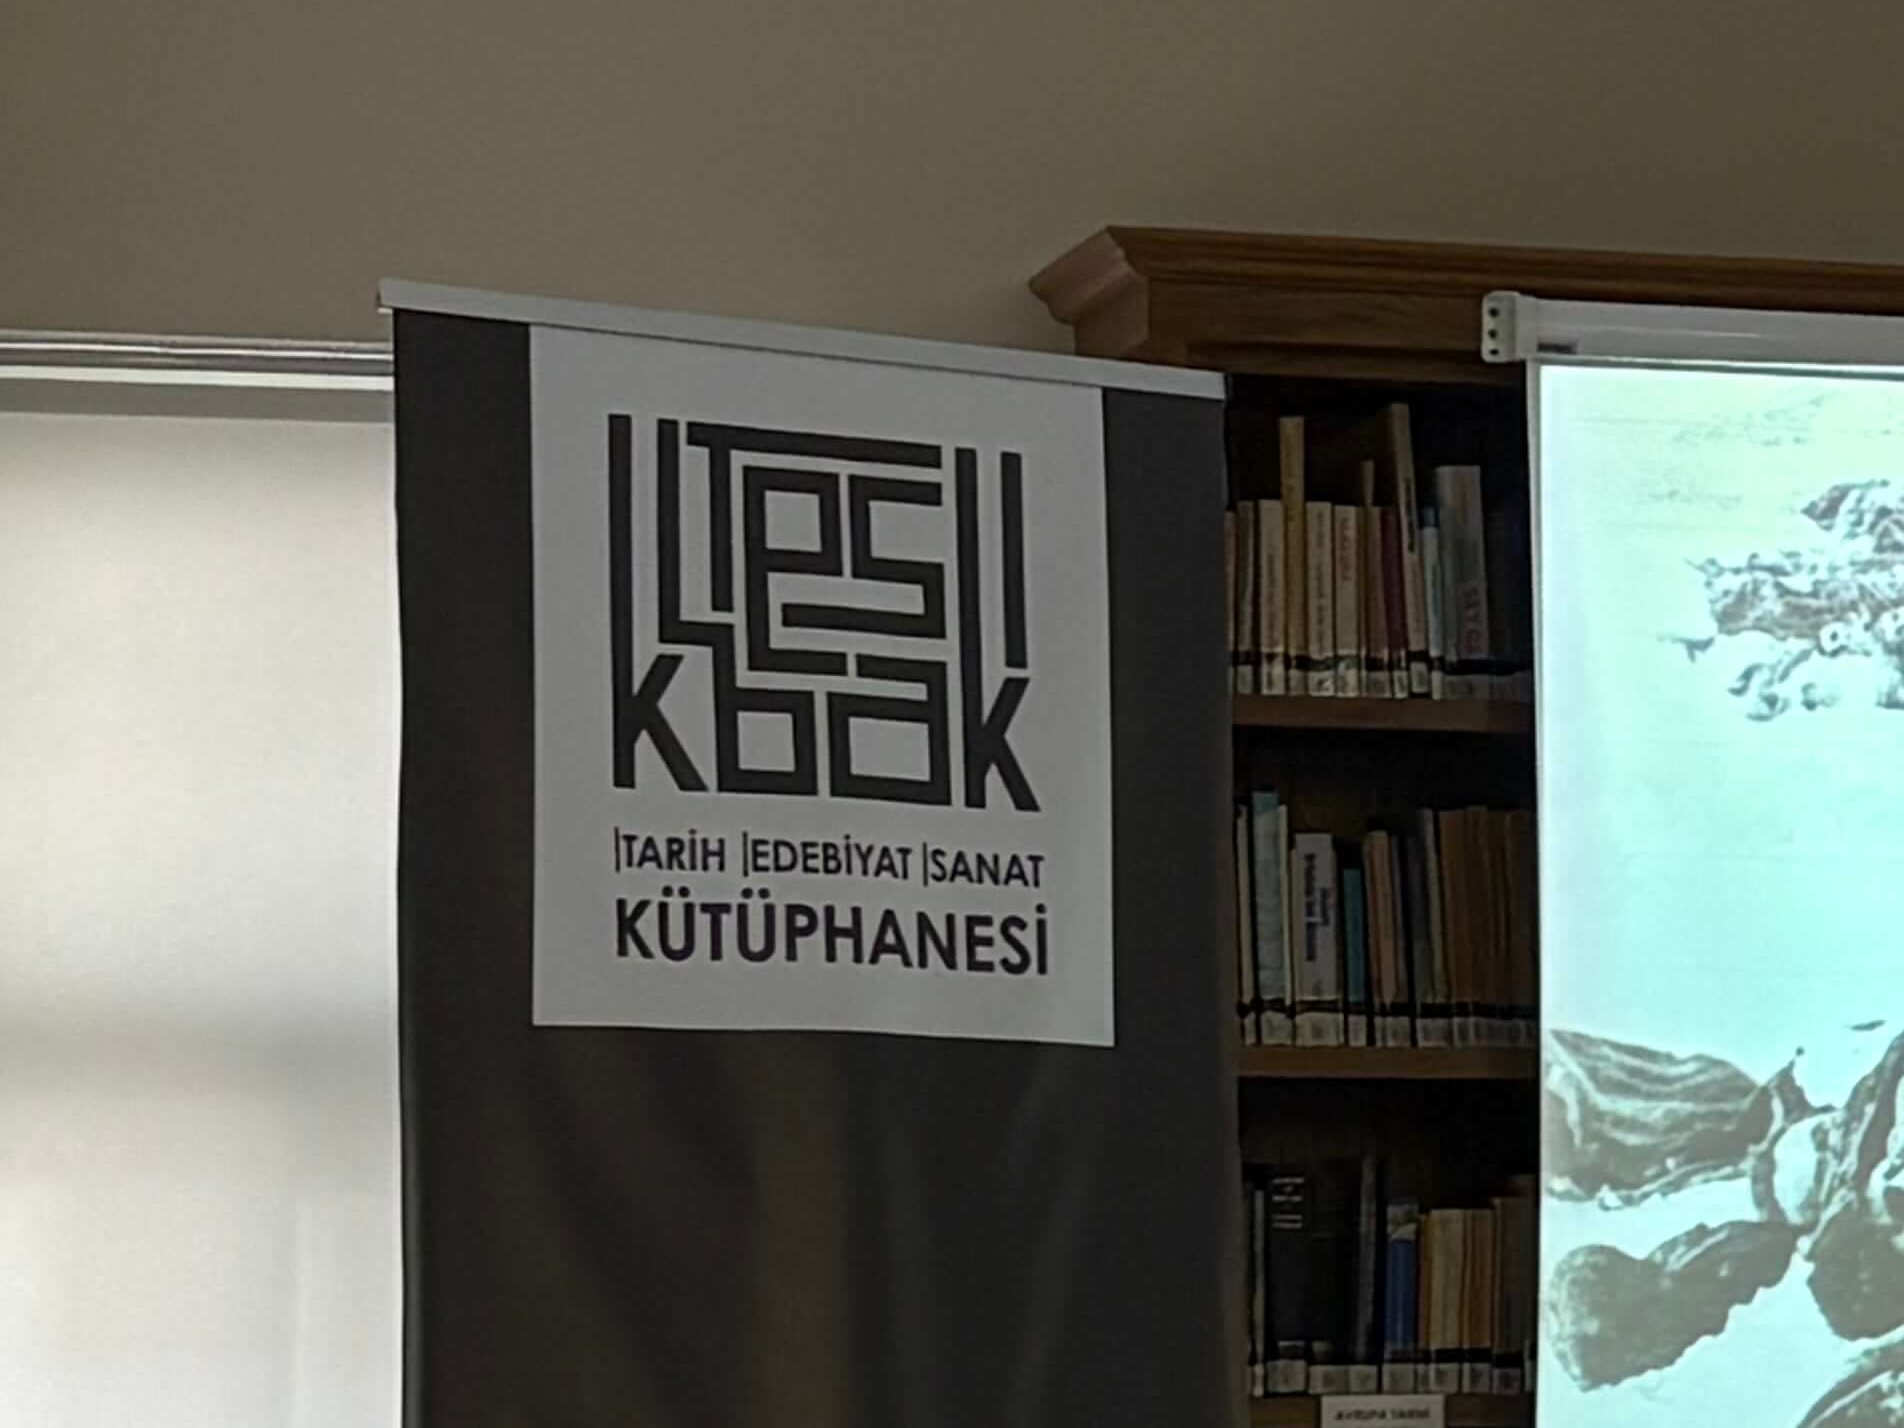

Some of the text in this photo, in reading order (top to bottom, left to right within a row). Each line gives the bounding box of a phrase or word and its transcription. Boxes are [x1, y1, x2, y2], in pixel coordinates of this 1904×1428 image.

[624, 829, 1045, 889] TARİH EDEBİYAT SANAT
[614, 886, 1051, 977] KÜTÜPHANESİ
